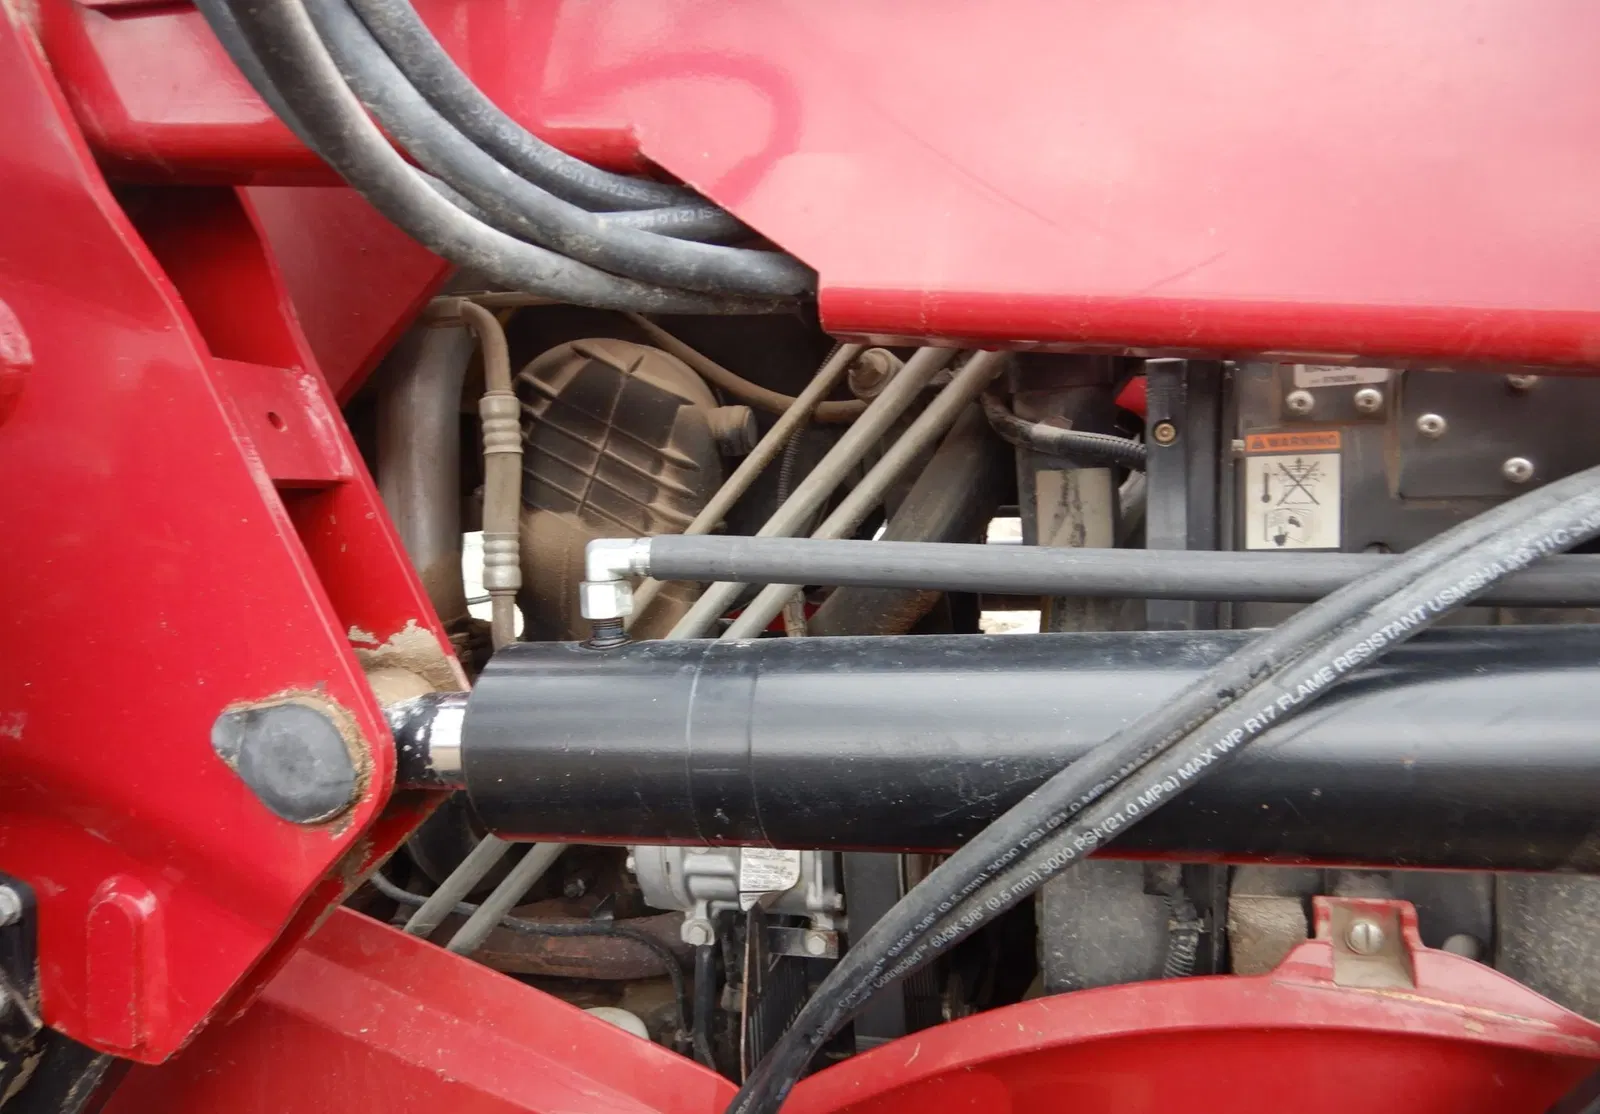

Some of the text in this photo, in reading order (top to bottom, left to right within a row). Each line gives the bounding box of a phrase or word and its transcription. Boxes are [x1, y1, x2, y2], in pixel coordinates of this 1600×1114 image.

[1269, 434, 1337, 447] WARNING
[930, 922, 965, 948] 6M3K
[961, 906, 984, 927] 3/8"
[1011, 870, 1042, 895] mm)
[1039, 847, 1076, 874] 3000
[1073, 827, 1102, 851] PSI
[1101, 802, 1139, 833] (21.0
[1138, 776, 1181, 807] MPa)
[1177, 748, 1218, 780] MAX
[1214, 728, 1244, 753] WP
[1244, 704, 1276, 734] R17
[1277, 666, 1336, 711] FLAME
[1332, 605, 1427, 672] RESISTANT
[1427, 562, 1506, 612] USMSHA
